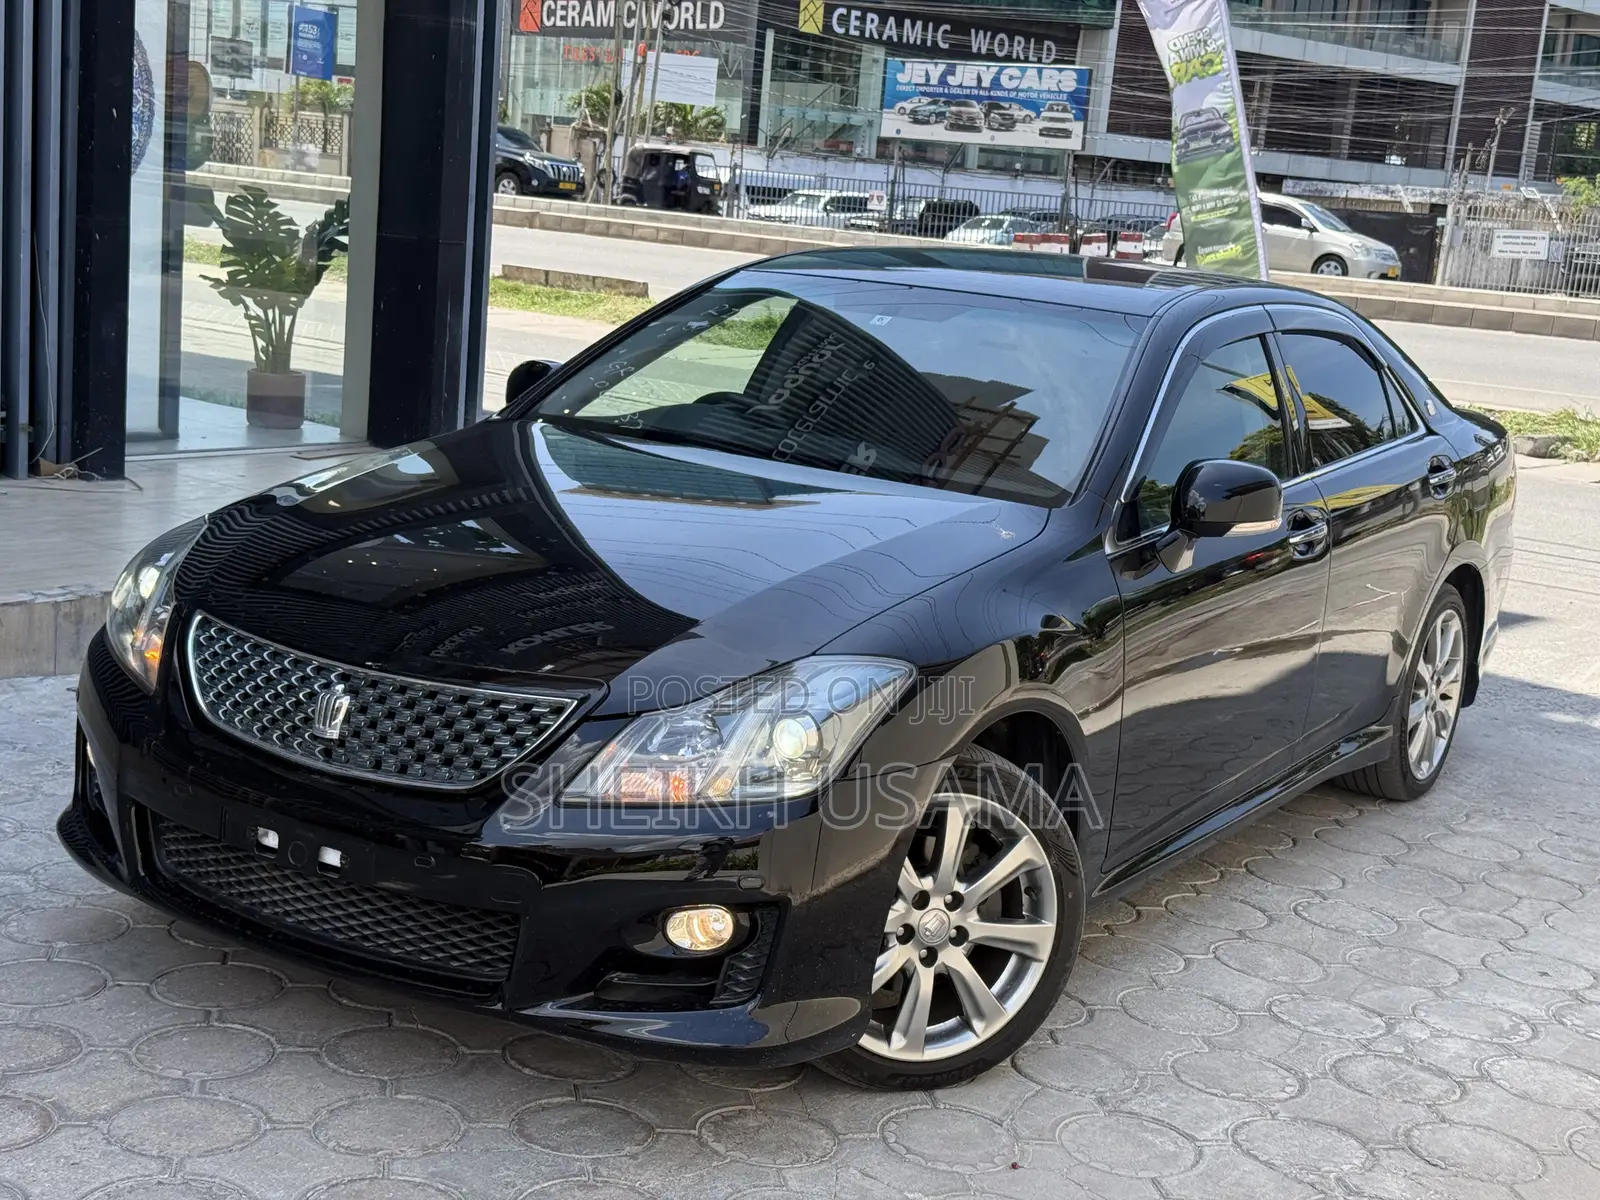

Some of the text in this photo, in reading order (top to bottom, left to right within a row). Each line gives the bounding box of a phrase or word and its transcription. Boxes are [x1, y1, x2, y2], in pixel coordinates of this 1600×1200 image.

[542, 0, 636, 28] CERAMC
[831, 7, 1057, 63] CERAMIC WORLD
[896, 62, 1077, 92] JEY JEY CARS
[896, 84, 915, 92] DIRECT
[949, 87, 970, 95] DEALER
[1018, 91, 1038, 99] MOTOR
[1039, 92, 1067, 100] VEHICLES
